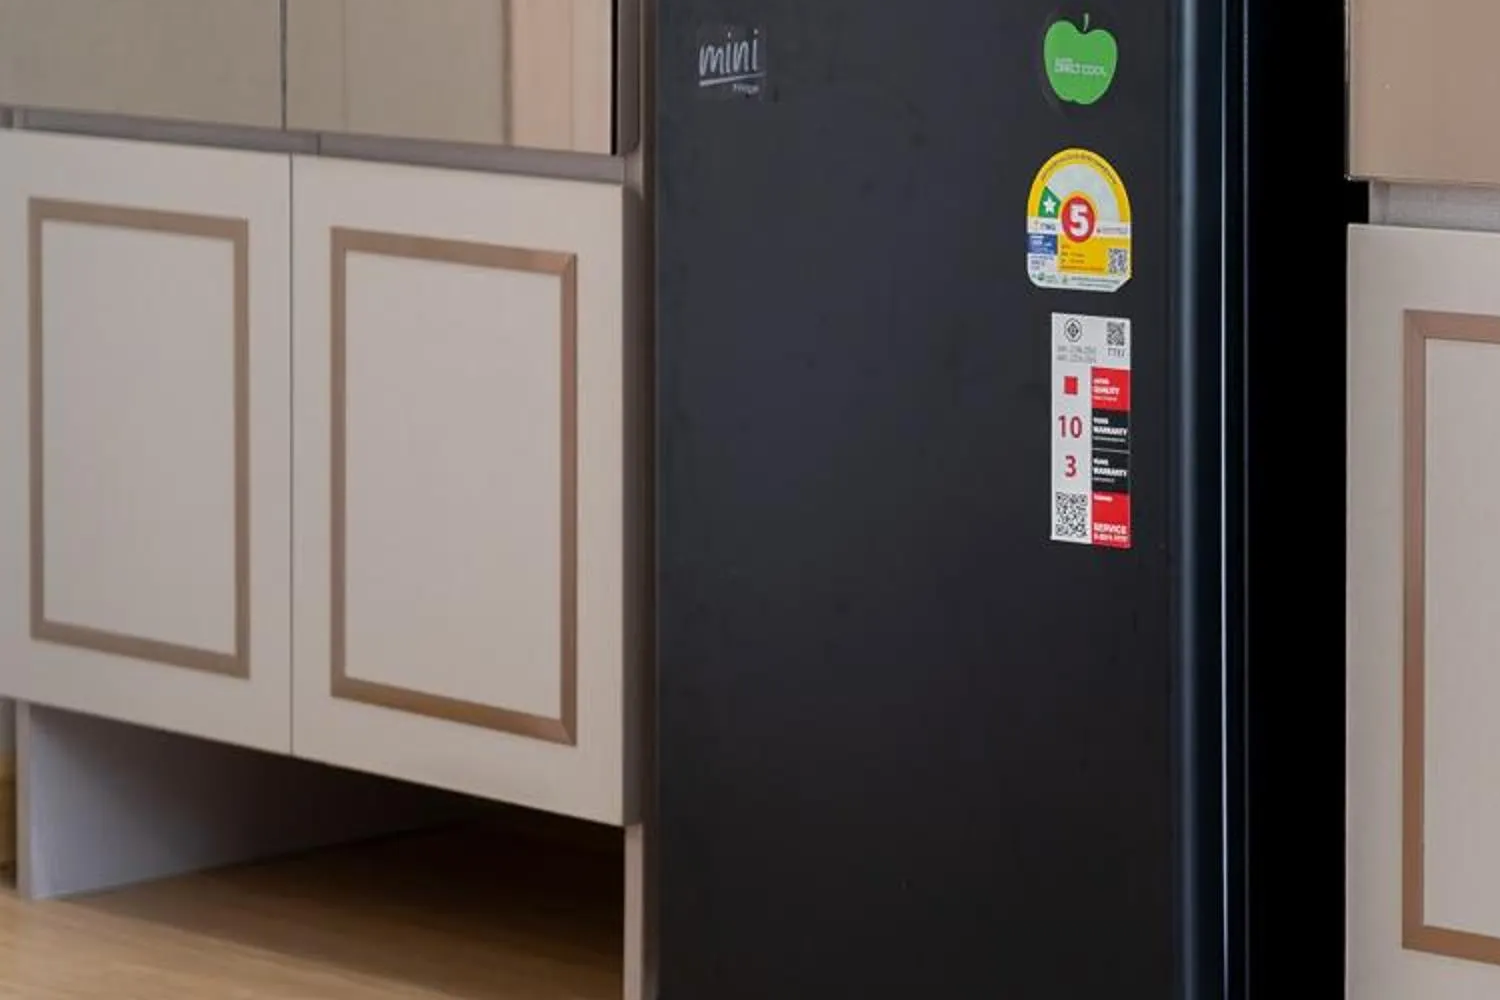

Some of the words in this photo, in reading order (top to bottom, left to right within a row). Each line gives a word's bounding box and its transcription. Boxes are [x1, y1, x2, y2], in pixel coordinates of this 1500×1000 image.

[699, 28, 759, 77] mini
[1069, 202, 1089, 237] 5
[1058, 415, 1082, 439] 10
[1064, 455, 1077, 478] 3
